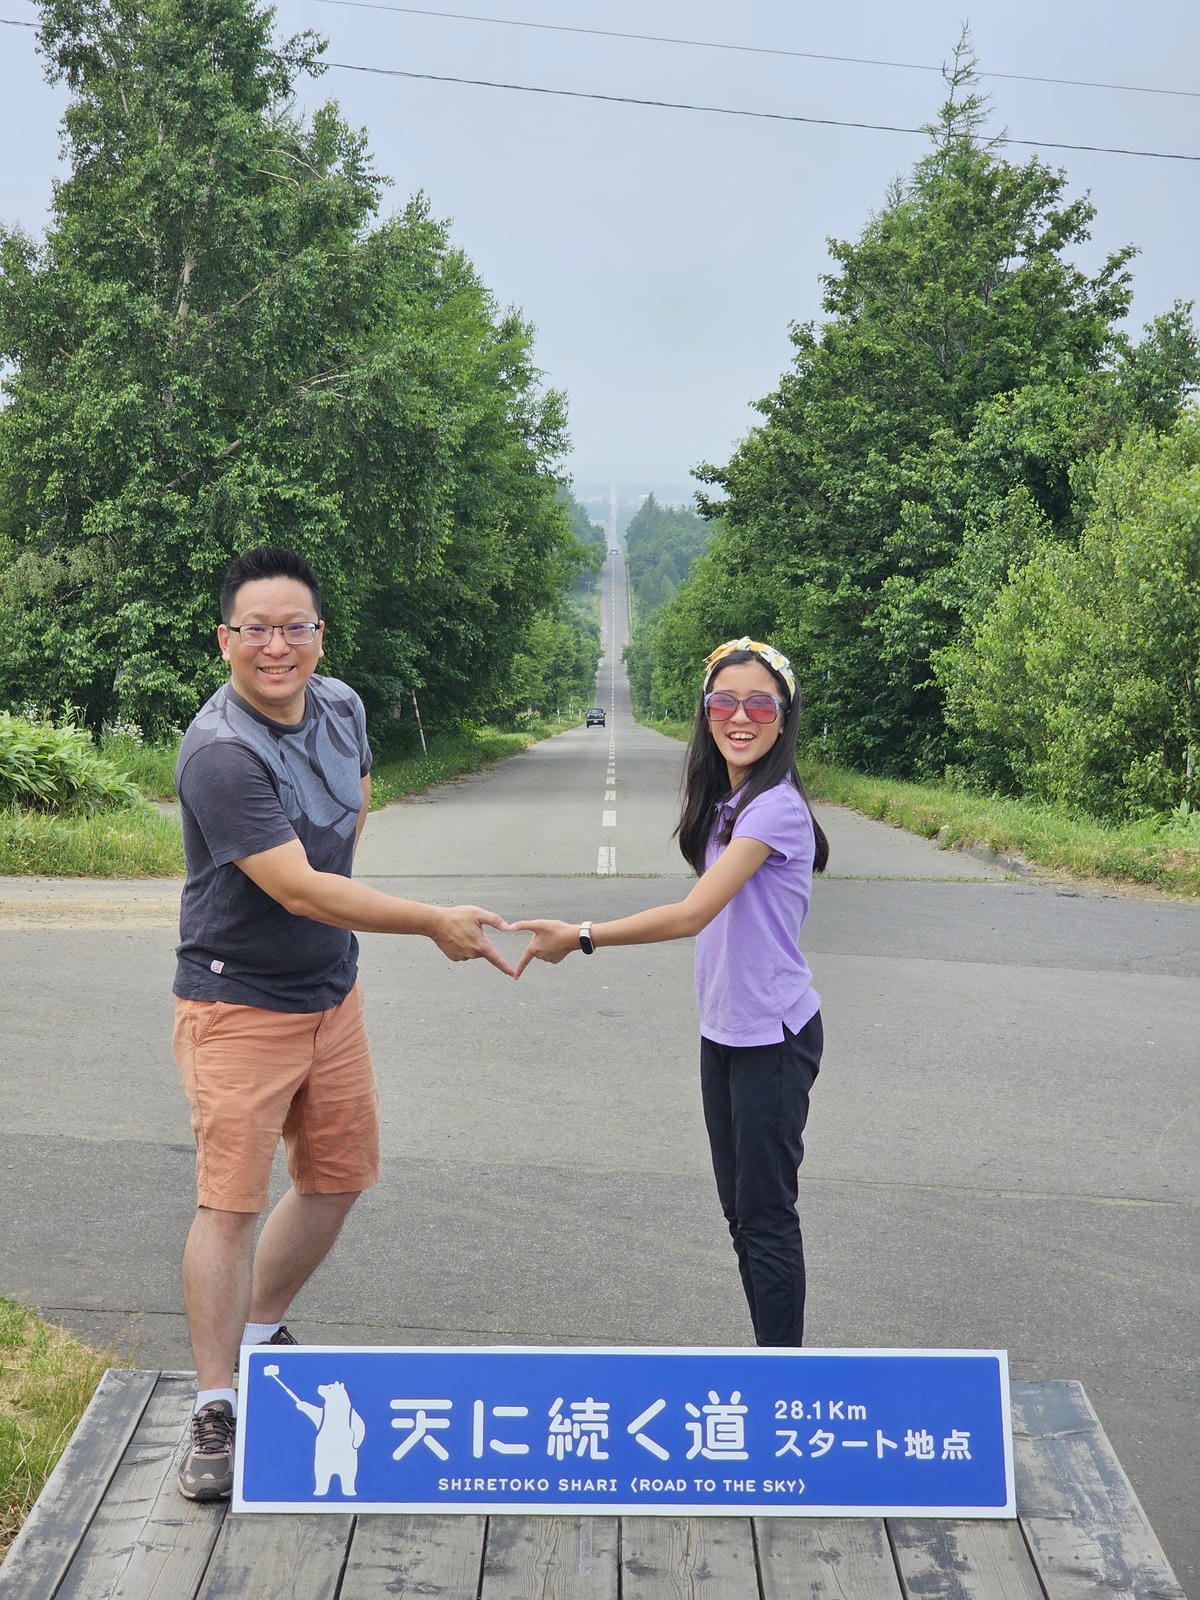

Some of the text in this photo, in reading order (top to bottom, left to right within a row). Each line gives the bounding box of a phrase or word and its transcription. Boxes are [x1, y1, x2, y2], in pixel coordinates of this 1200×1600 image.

[389, 1390, 749, 1461] 天に続く道
[774, 1428, 973, 1460] スタート地点
[438, 1478, 550, 1491] SHIRETOKO
[558, 1478, 617, 1492] SHARI
[693, 1479, 716, 1492] TO
[722, 1479, 756, 1492] THE
